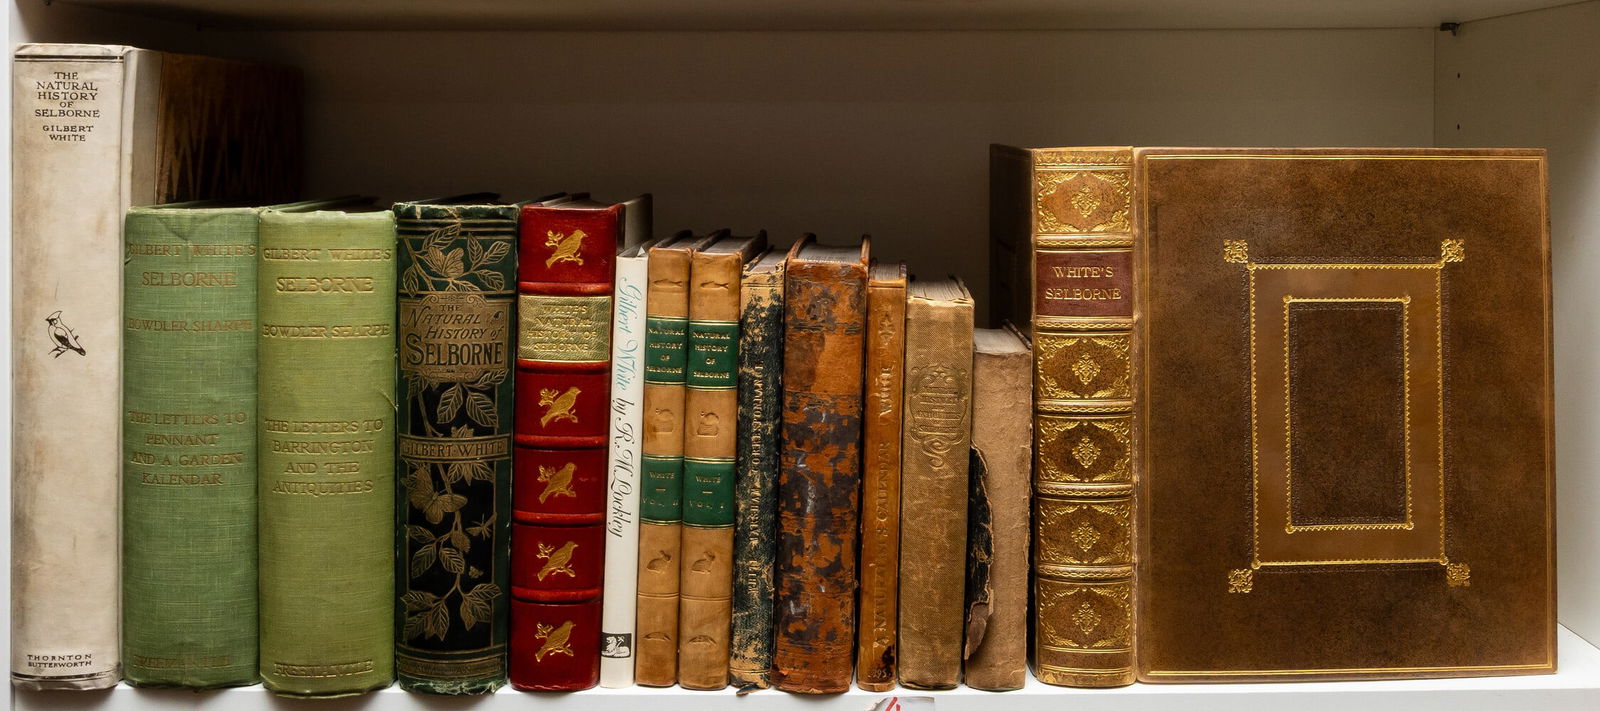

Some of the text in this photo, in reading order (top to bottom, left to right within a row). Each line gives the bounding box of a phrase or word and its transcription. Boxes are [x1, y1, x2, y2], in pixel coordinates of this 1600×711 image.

[54, 71, 79, 80] THE
[36, 81, 98, 91] NATURAL
[37, 91, 98, 101] HISTORY
[35, 109, 100, 118] SELBORNE
[42, 125, 94, 133] GILBERT
[49, 134, 86, 142] WHITE
[263, 248, 392, 261] GILBERT WHITE'S
[1052, 266, 1114, 278] WHITE'S
[141, 271, 239, 288] SELBORNE
[276, 277, 374, 293] SELBORNE
[1045, 288, 1122, 300] SELBORNE
[440, 304, 461, 312] THE
[618, 276, 642, 334] Gilbert
[403, 305, 481, 328] NATURAL
[263, 324, 390, 338] BOWDLER SHARPE
[424, 325, 505, 341] HISTORY of
[405, 333, 504, 366] SELBORNE
[616, 339, 639, 391] White
[612, 397, 635, 416] by
[154, 412, 219, 426] LETTERS
[224, 411, 248, 425] TO
[264, 417, 384, 434] THE LETTERS TO
[145, 433, 220, 447] PENNANT
[271, 439, 375, 455] BARRINGTON
[131, 451, 245, 467] AND A GARDEN
[284, 461, 360, 475] AND THE
[141, 472, 224, 486] KALENDAR
[272, 480, 374, 498] ANTIQUITIES
[27, 653, 92, 662] THORNTON
